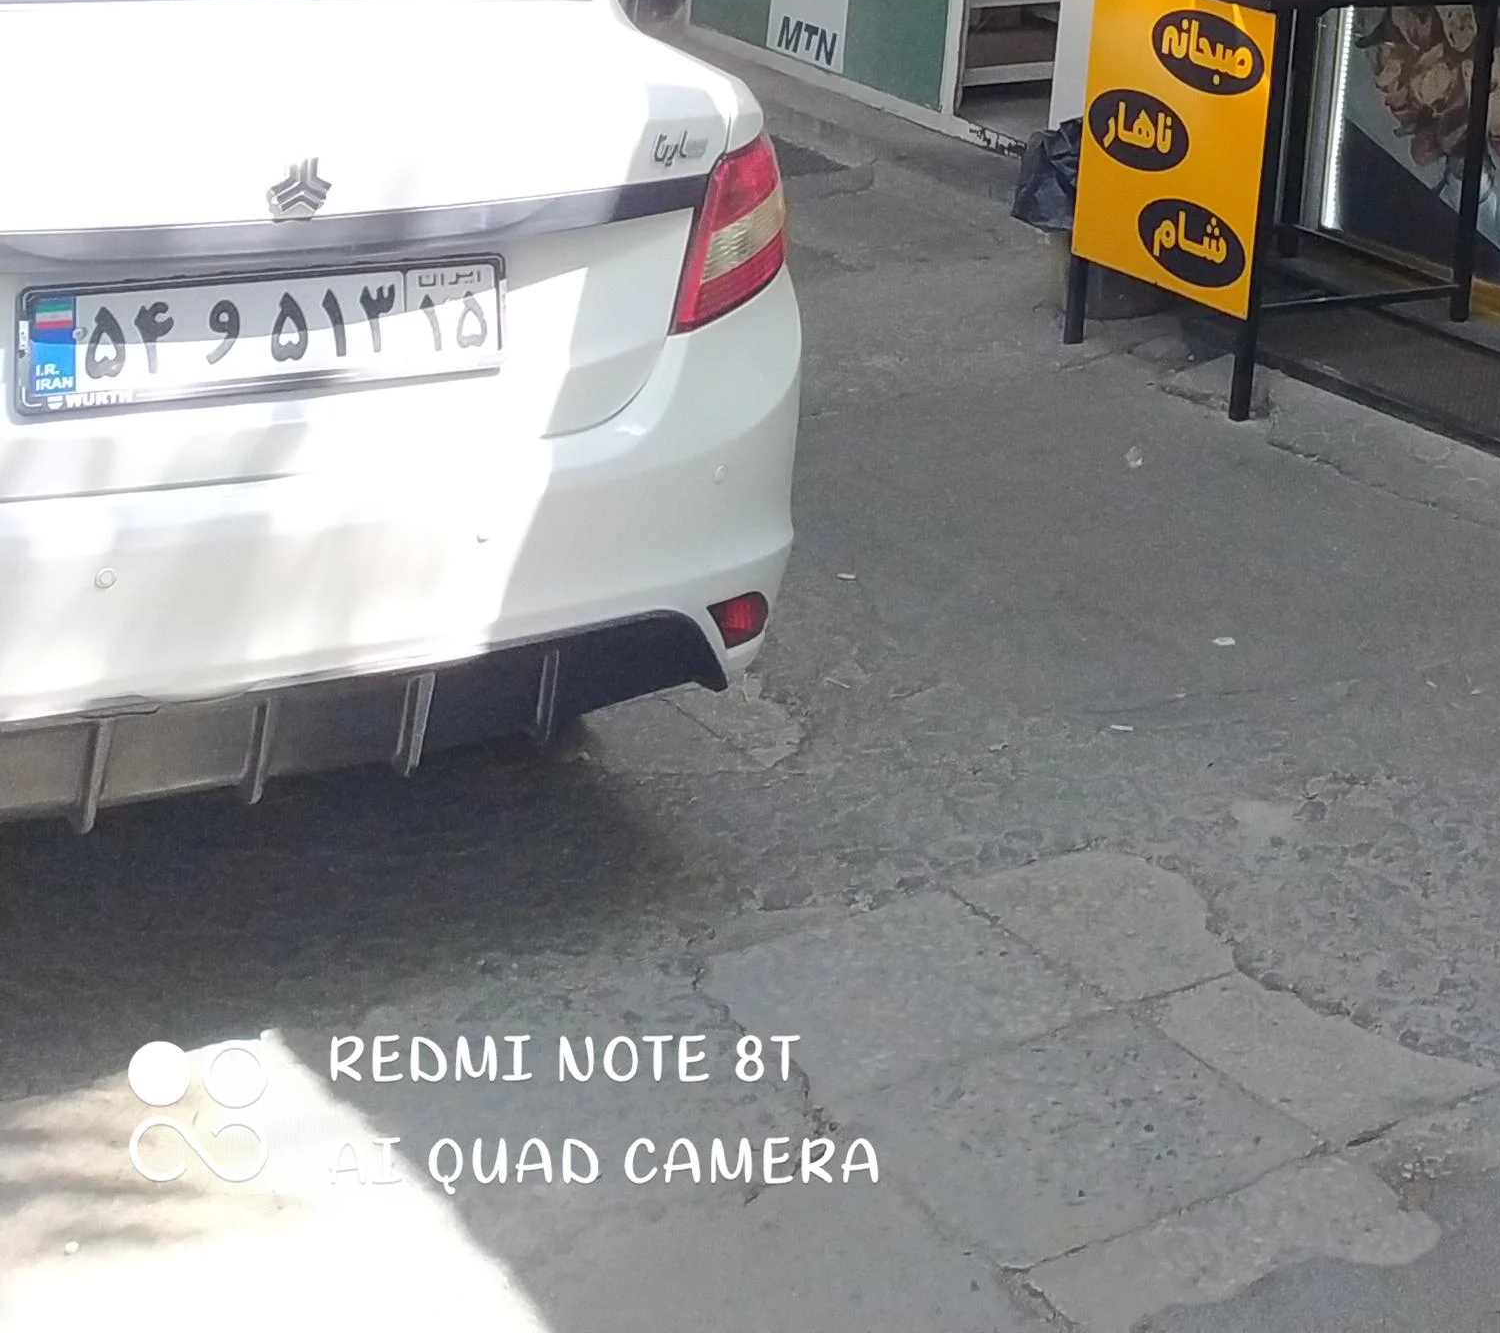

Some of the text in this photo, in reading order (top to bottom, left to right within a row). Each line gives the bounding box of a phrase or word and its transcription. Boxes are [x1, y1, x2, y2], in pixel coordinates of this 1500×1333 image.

[776, 13, 838, 67] MTN
[1160, 15, 1255, 85] صبحانه
[1102, 106, 1173, 156] ناهار
[1151, 211, 1227, 265] شام
[417, 268, 482, 288] ایران
[35, 363, 60, 376] I.R.
[35, 375, 74, 390] IRAN
